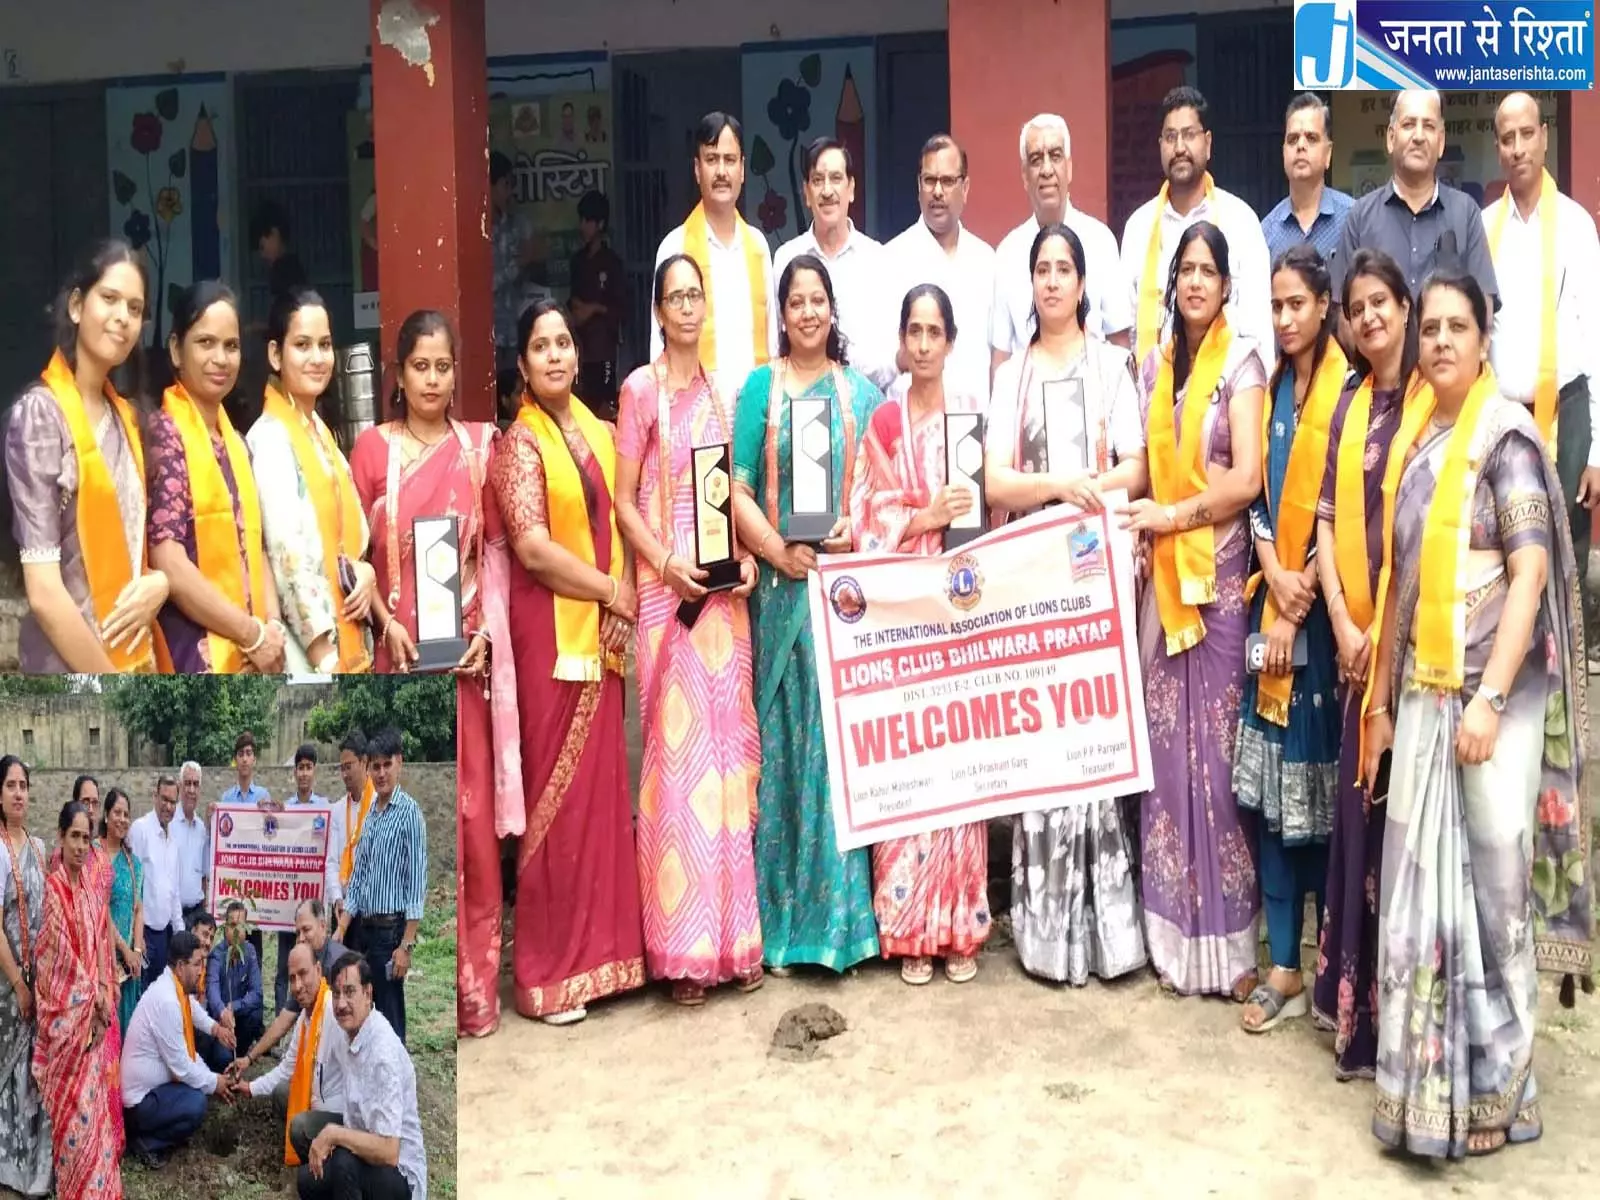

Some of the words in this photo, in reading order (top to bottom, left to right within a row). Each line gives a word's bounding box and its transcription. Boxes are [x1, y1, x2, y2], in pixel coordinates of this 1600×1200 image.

[853, 632, 872, 649] THE
[875, 622, 948, 645] INTERNATIONAL
[950, 608, 1012, 635] ASSOCIATION
[1014, 604, 1028, 620] OF
[1029, 599, 1059, 617] LIONS
[1060, 595, 1092, 613] CLUBS
[840, 657, 895, 690] LIONS
[898, 650, 945, 679] CLUB
[947, 631, 1040, 668] BHILWARA
[1042, 618, 1112, 653] PRATAP
[850, 687, 1042, 767] WELCOMES
[1047, 673, 1120, 729] YOU
[951, 767, 966, 781] Lion
[292, 881, 320, 901] YOU
